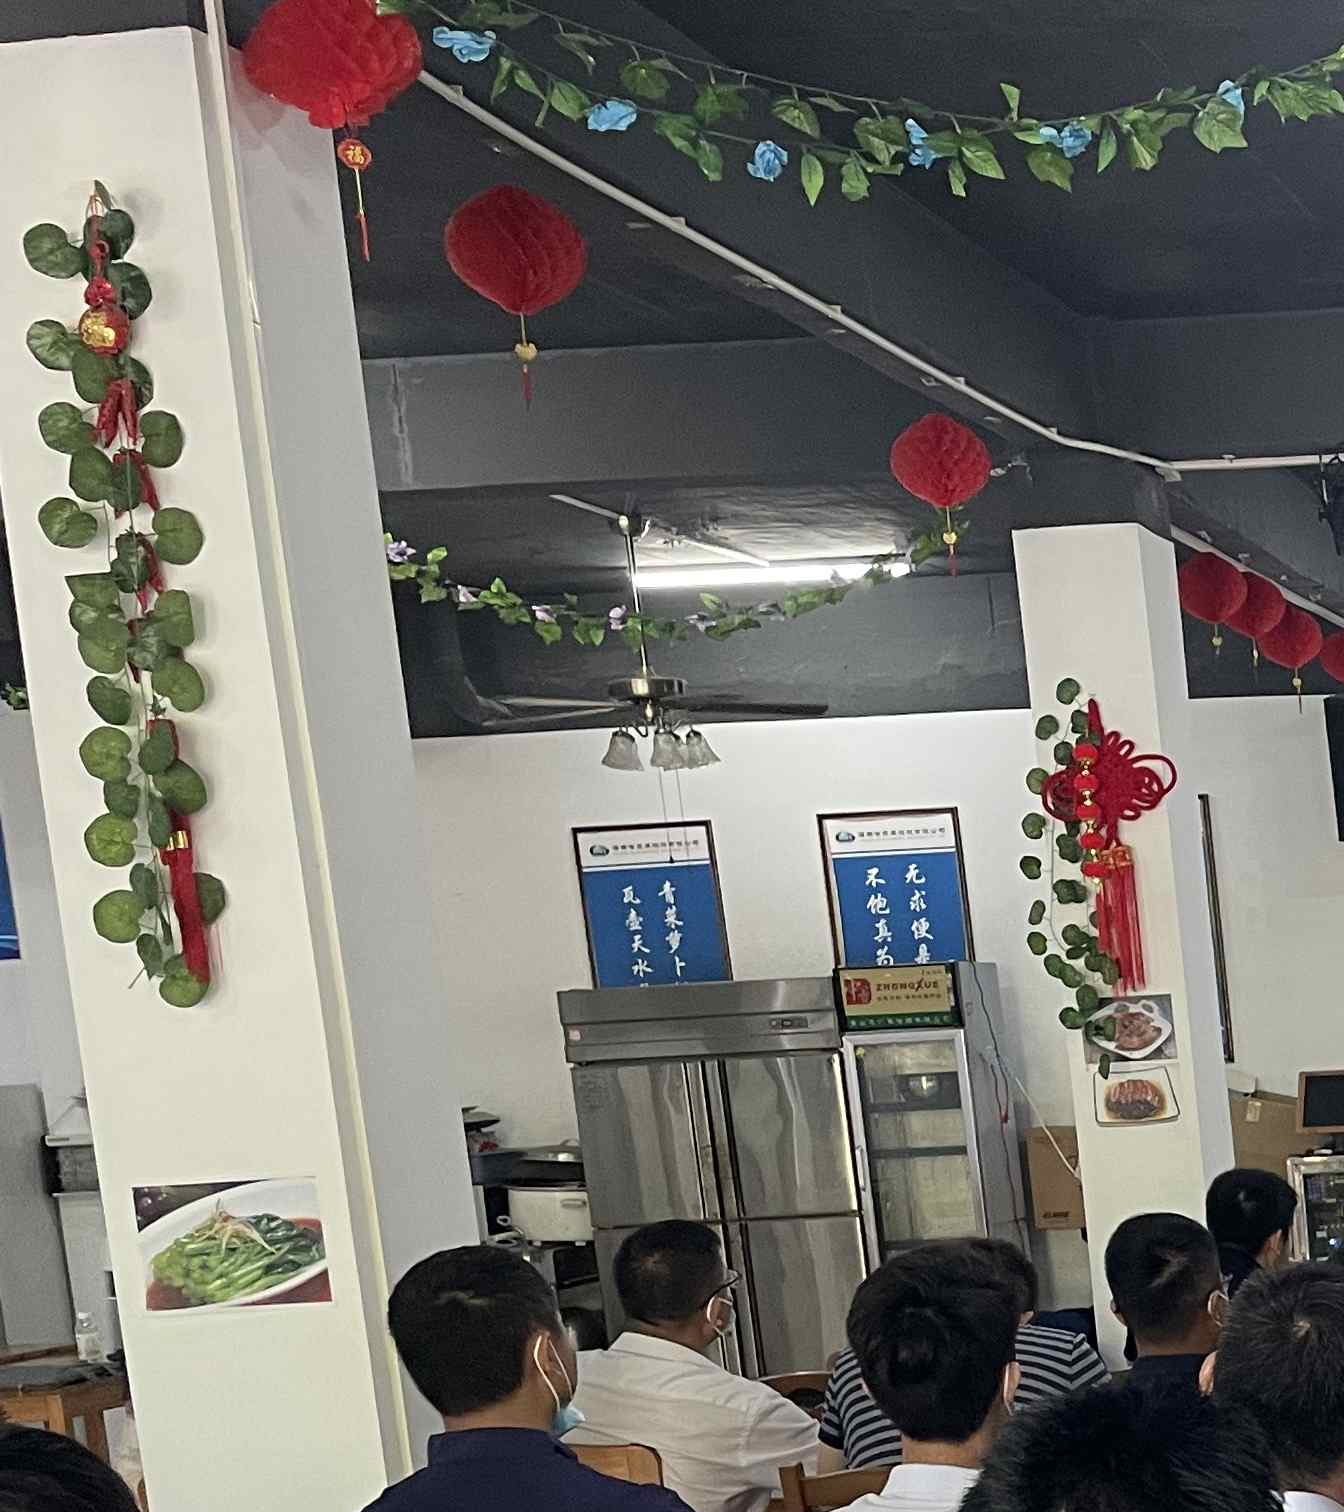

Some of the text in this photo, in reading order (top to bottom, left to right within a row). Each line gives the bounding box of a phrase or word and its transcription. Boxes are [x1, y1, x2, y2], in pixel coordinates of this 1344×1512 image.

[622, 886, 653, 987] 瓦壶天水
[658, 880, 688, 984] 青菜萝卜
